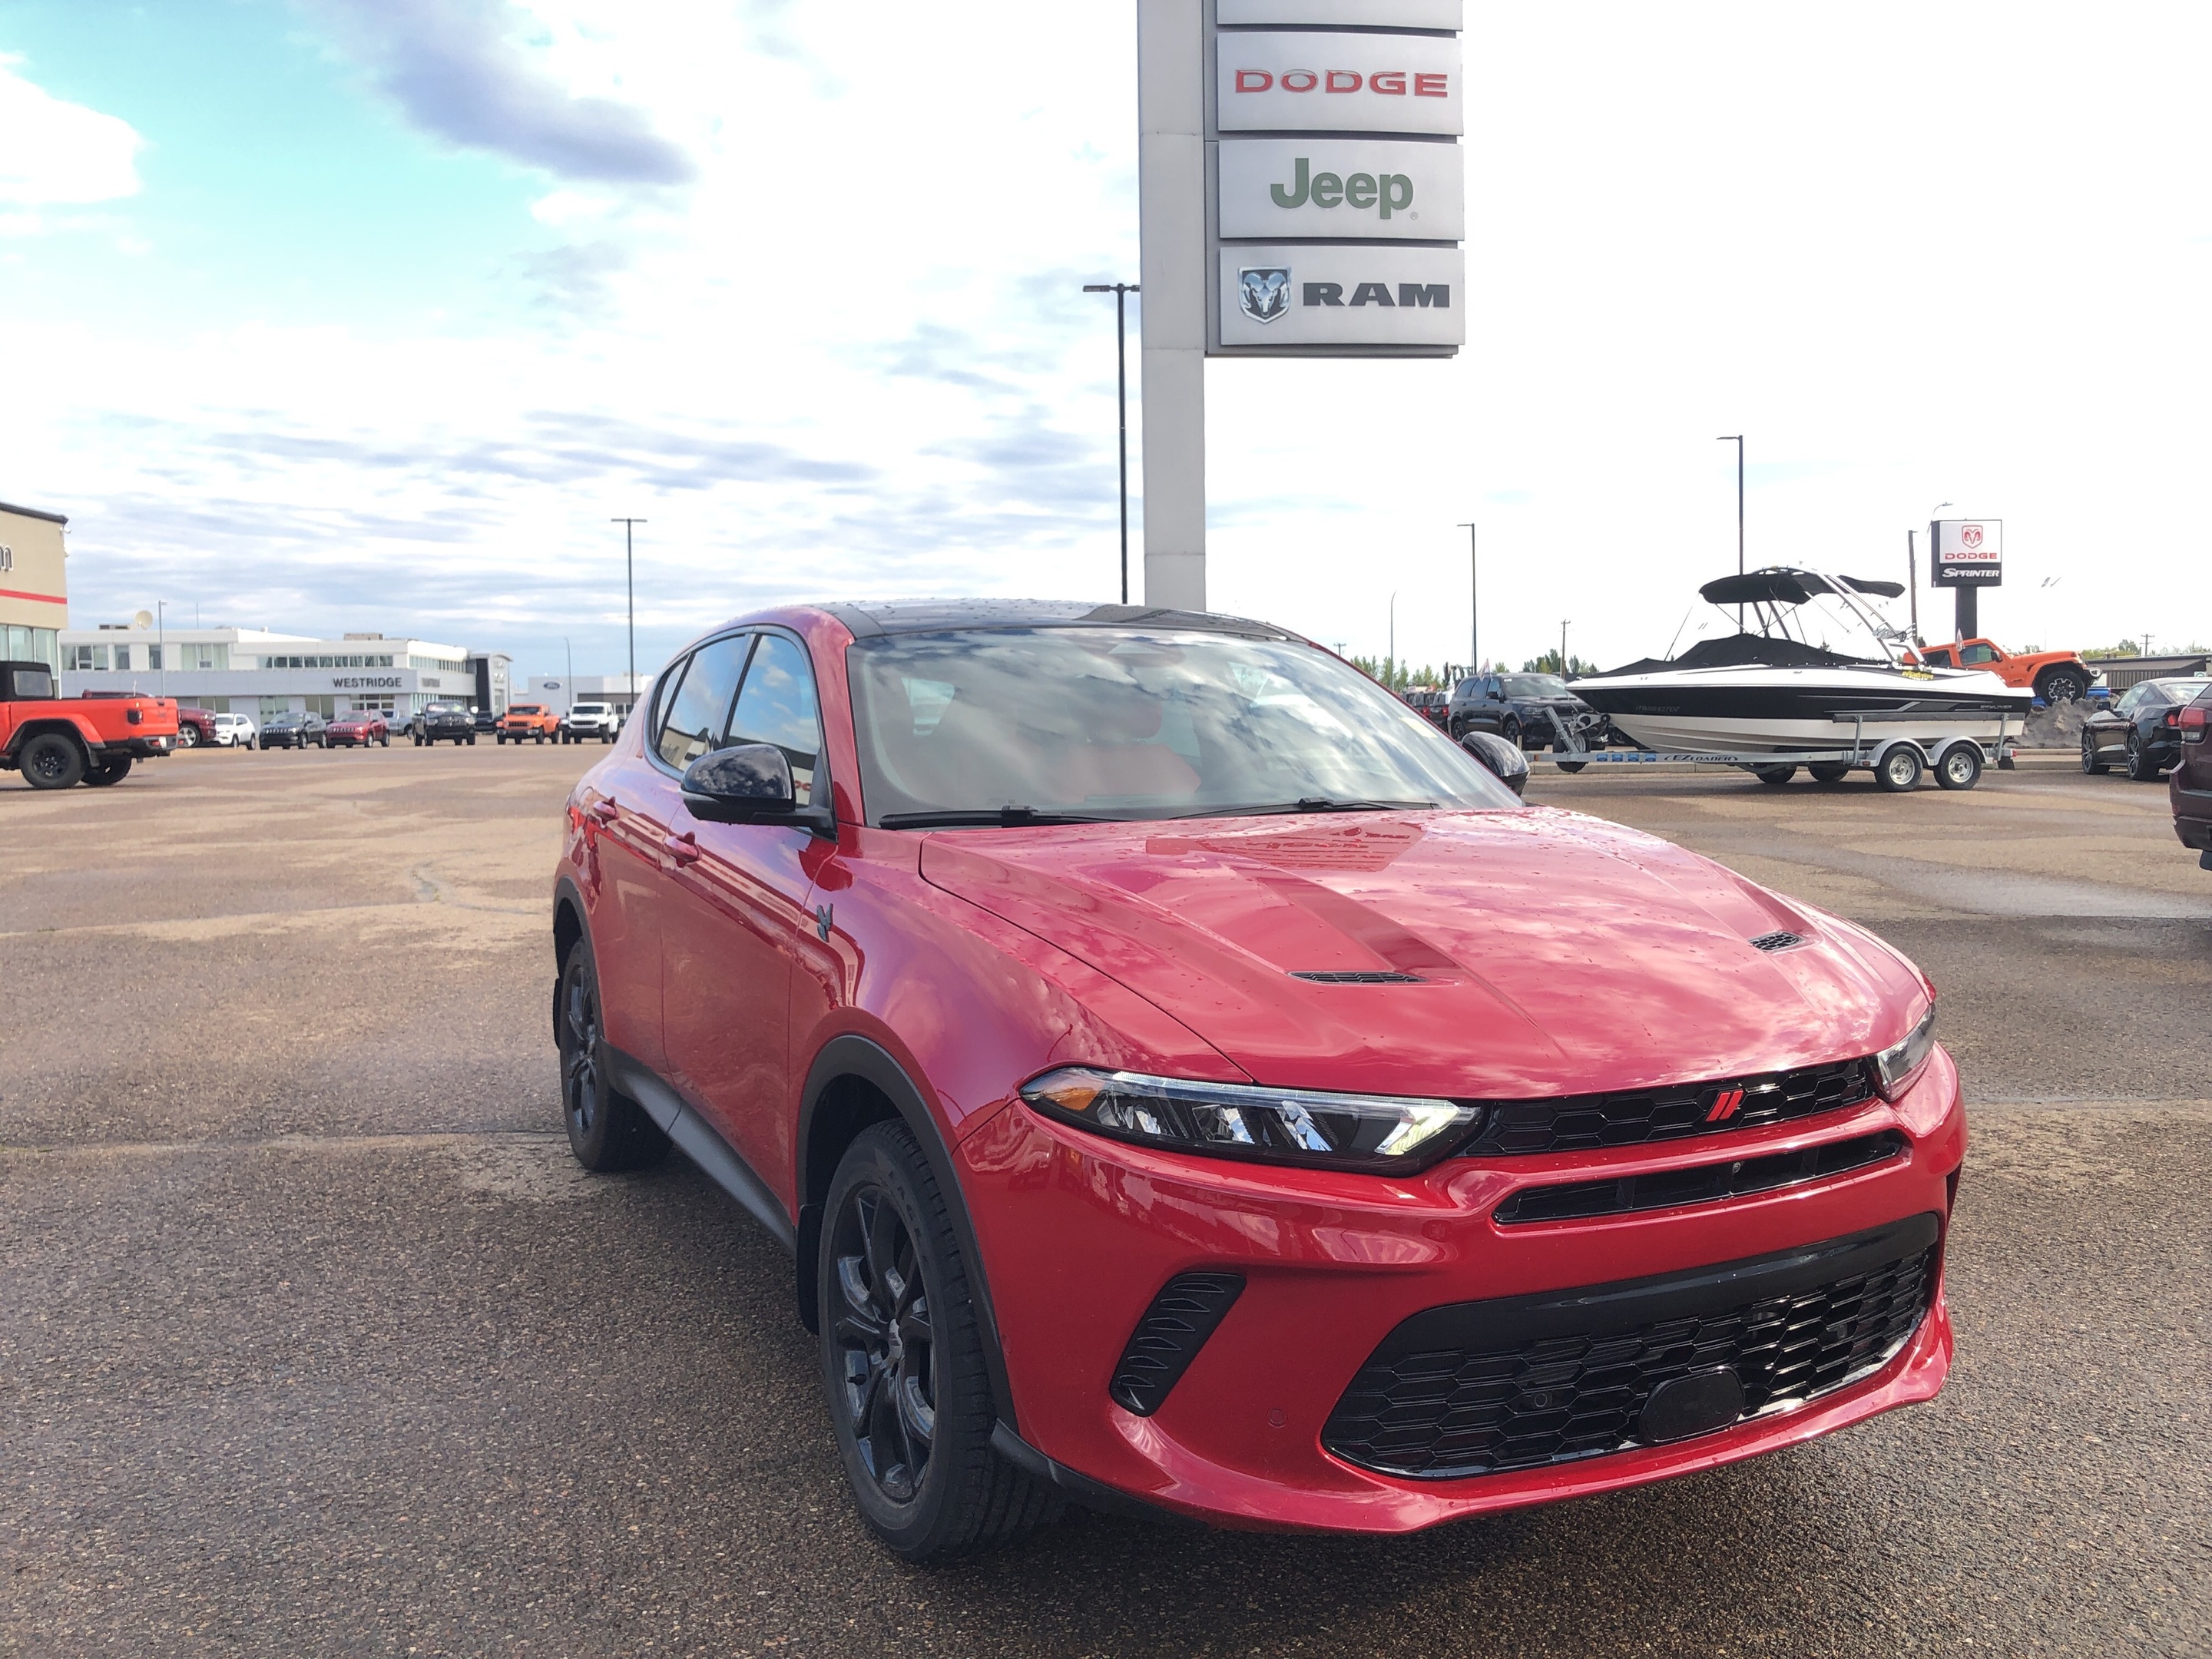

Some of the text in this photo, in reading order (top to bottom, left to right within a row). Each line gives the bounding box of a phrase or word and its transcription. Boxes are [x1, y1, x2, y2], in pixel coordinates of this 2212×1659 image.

[1235, 68, 1448, 98] DODGE
[1270, 157, 1414, 220] Jeep
[1303, 282, 1450, 308] RAM
[1942, 568, 1999, 578] SPRINTER
[333, 677, 402, 687] WESTRIDGE
